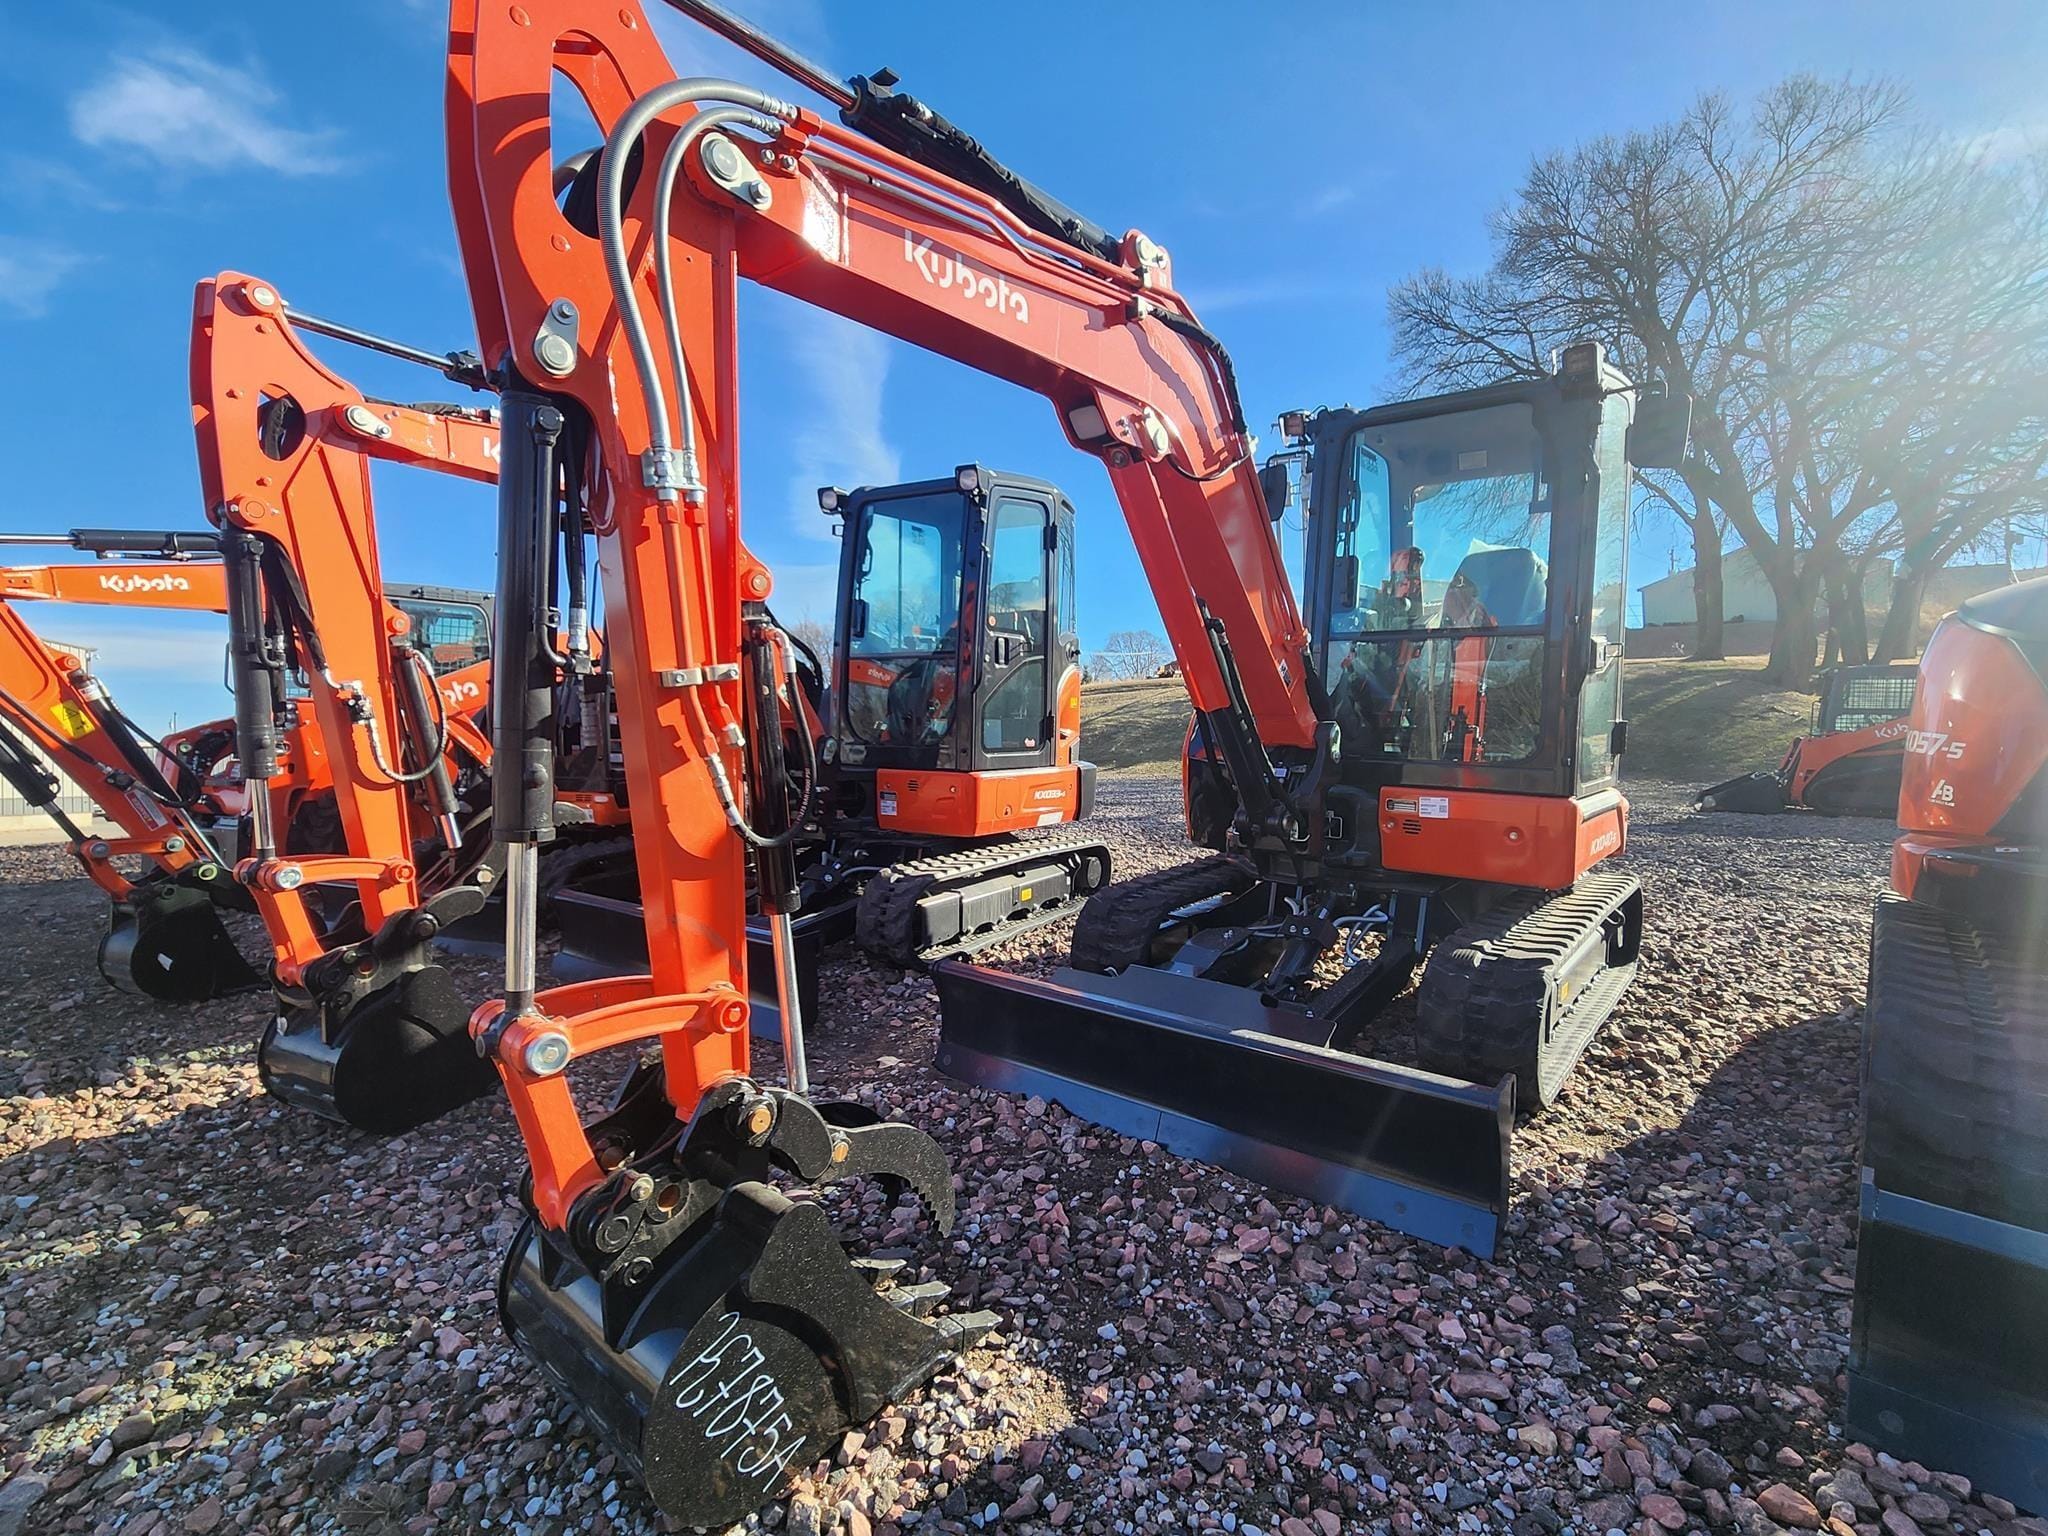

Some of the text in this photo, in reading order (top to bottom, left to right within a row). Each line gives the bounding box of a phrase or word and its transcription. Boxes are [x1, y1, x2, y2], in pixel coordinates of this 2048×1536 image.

[904, 229, 1029, 324] Kubota
[99, 574, 189, 592] Kubota
[444, 681, 479, 703] ota
[1875, 723, 1909, 738] Kub
[1906, 730, 1967, 759] 057-5
